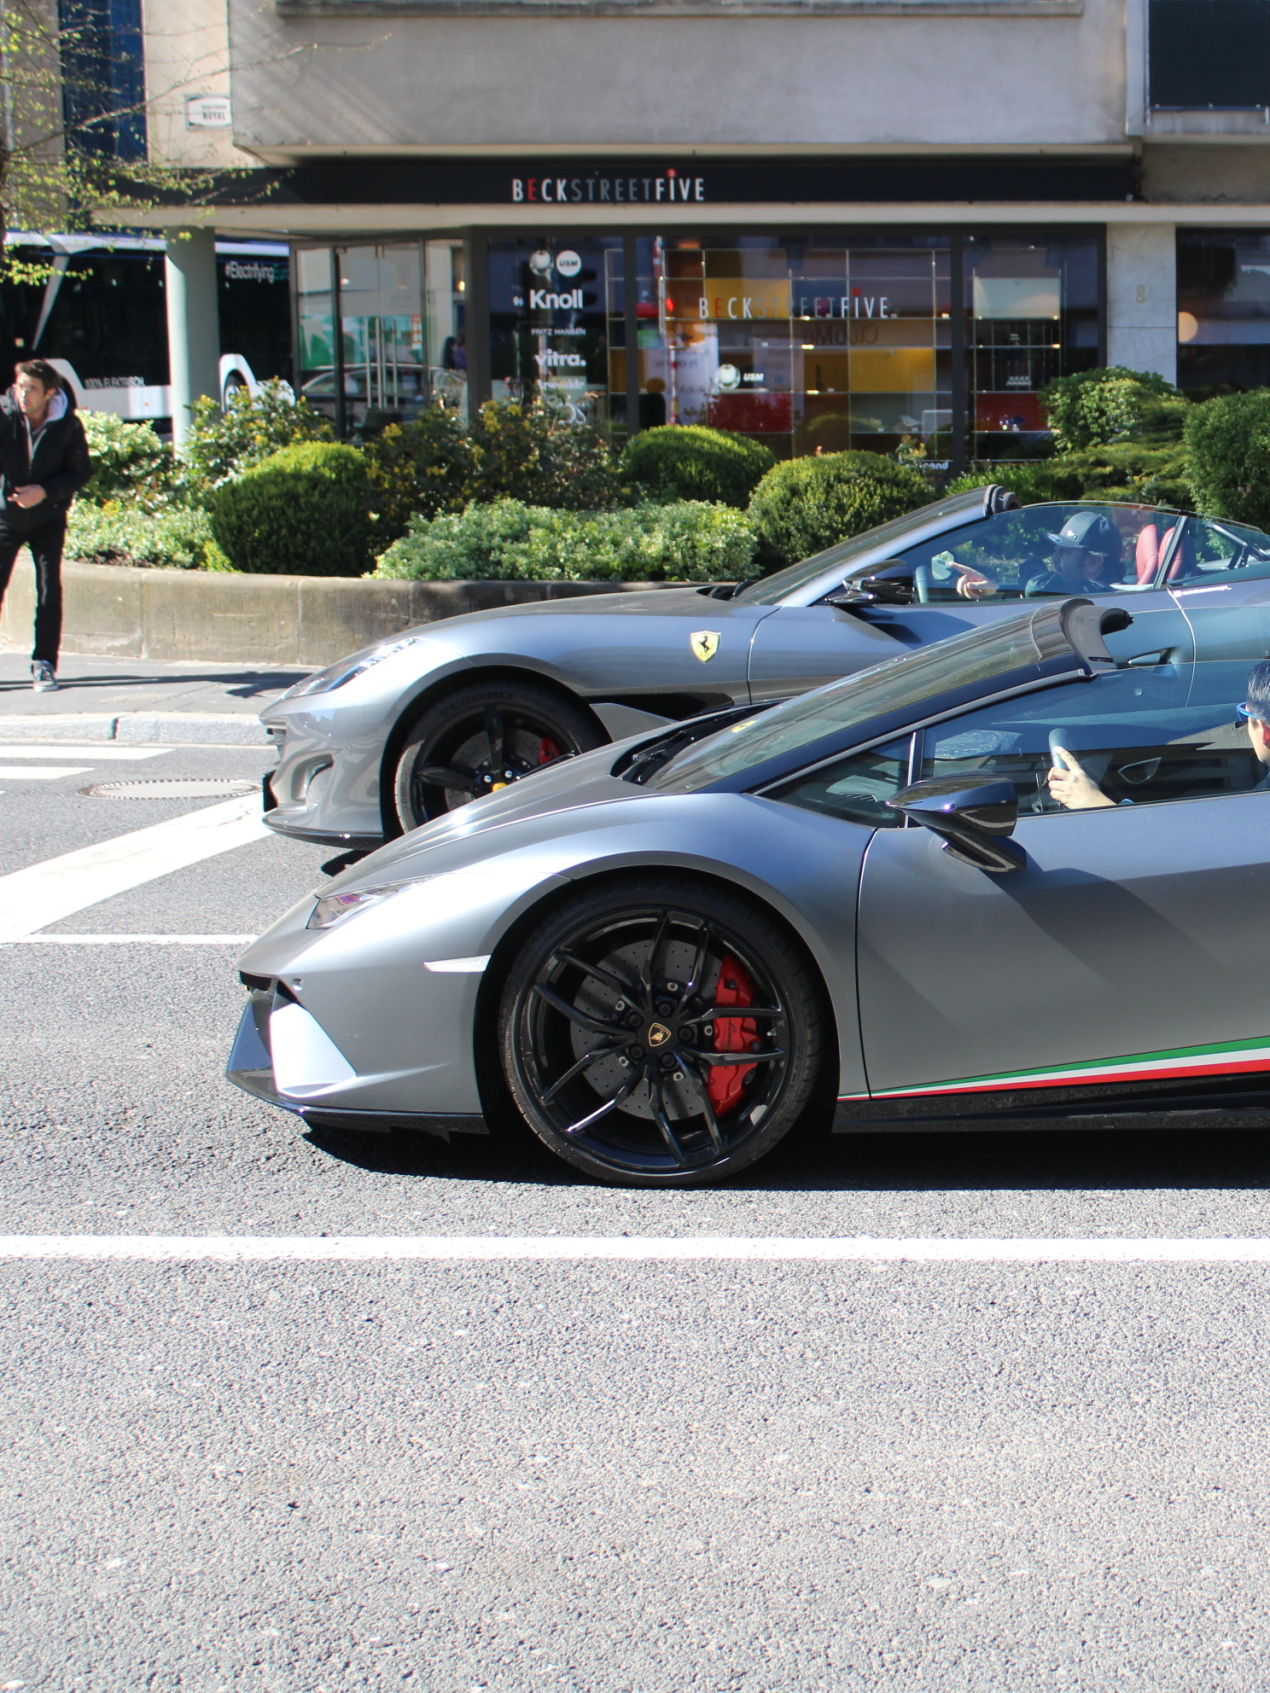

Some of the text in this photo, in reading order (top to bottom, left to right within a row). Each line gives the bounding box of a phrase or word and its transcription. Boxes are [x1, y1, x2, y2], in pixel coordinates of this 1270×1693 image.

[559, 259, 578, 267] USM
[529, 289, 584, 309] Knoll
[1135, 284, 1147, 304] 8
[534, 348, 587, 367] vitra.
[743, 373, 764, 382] USM
